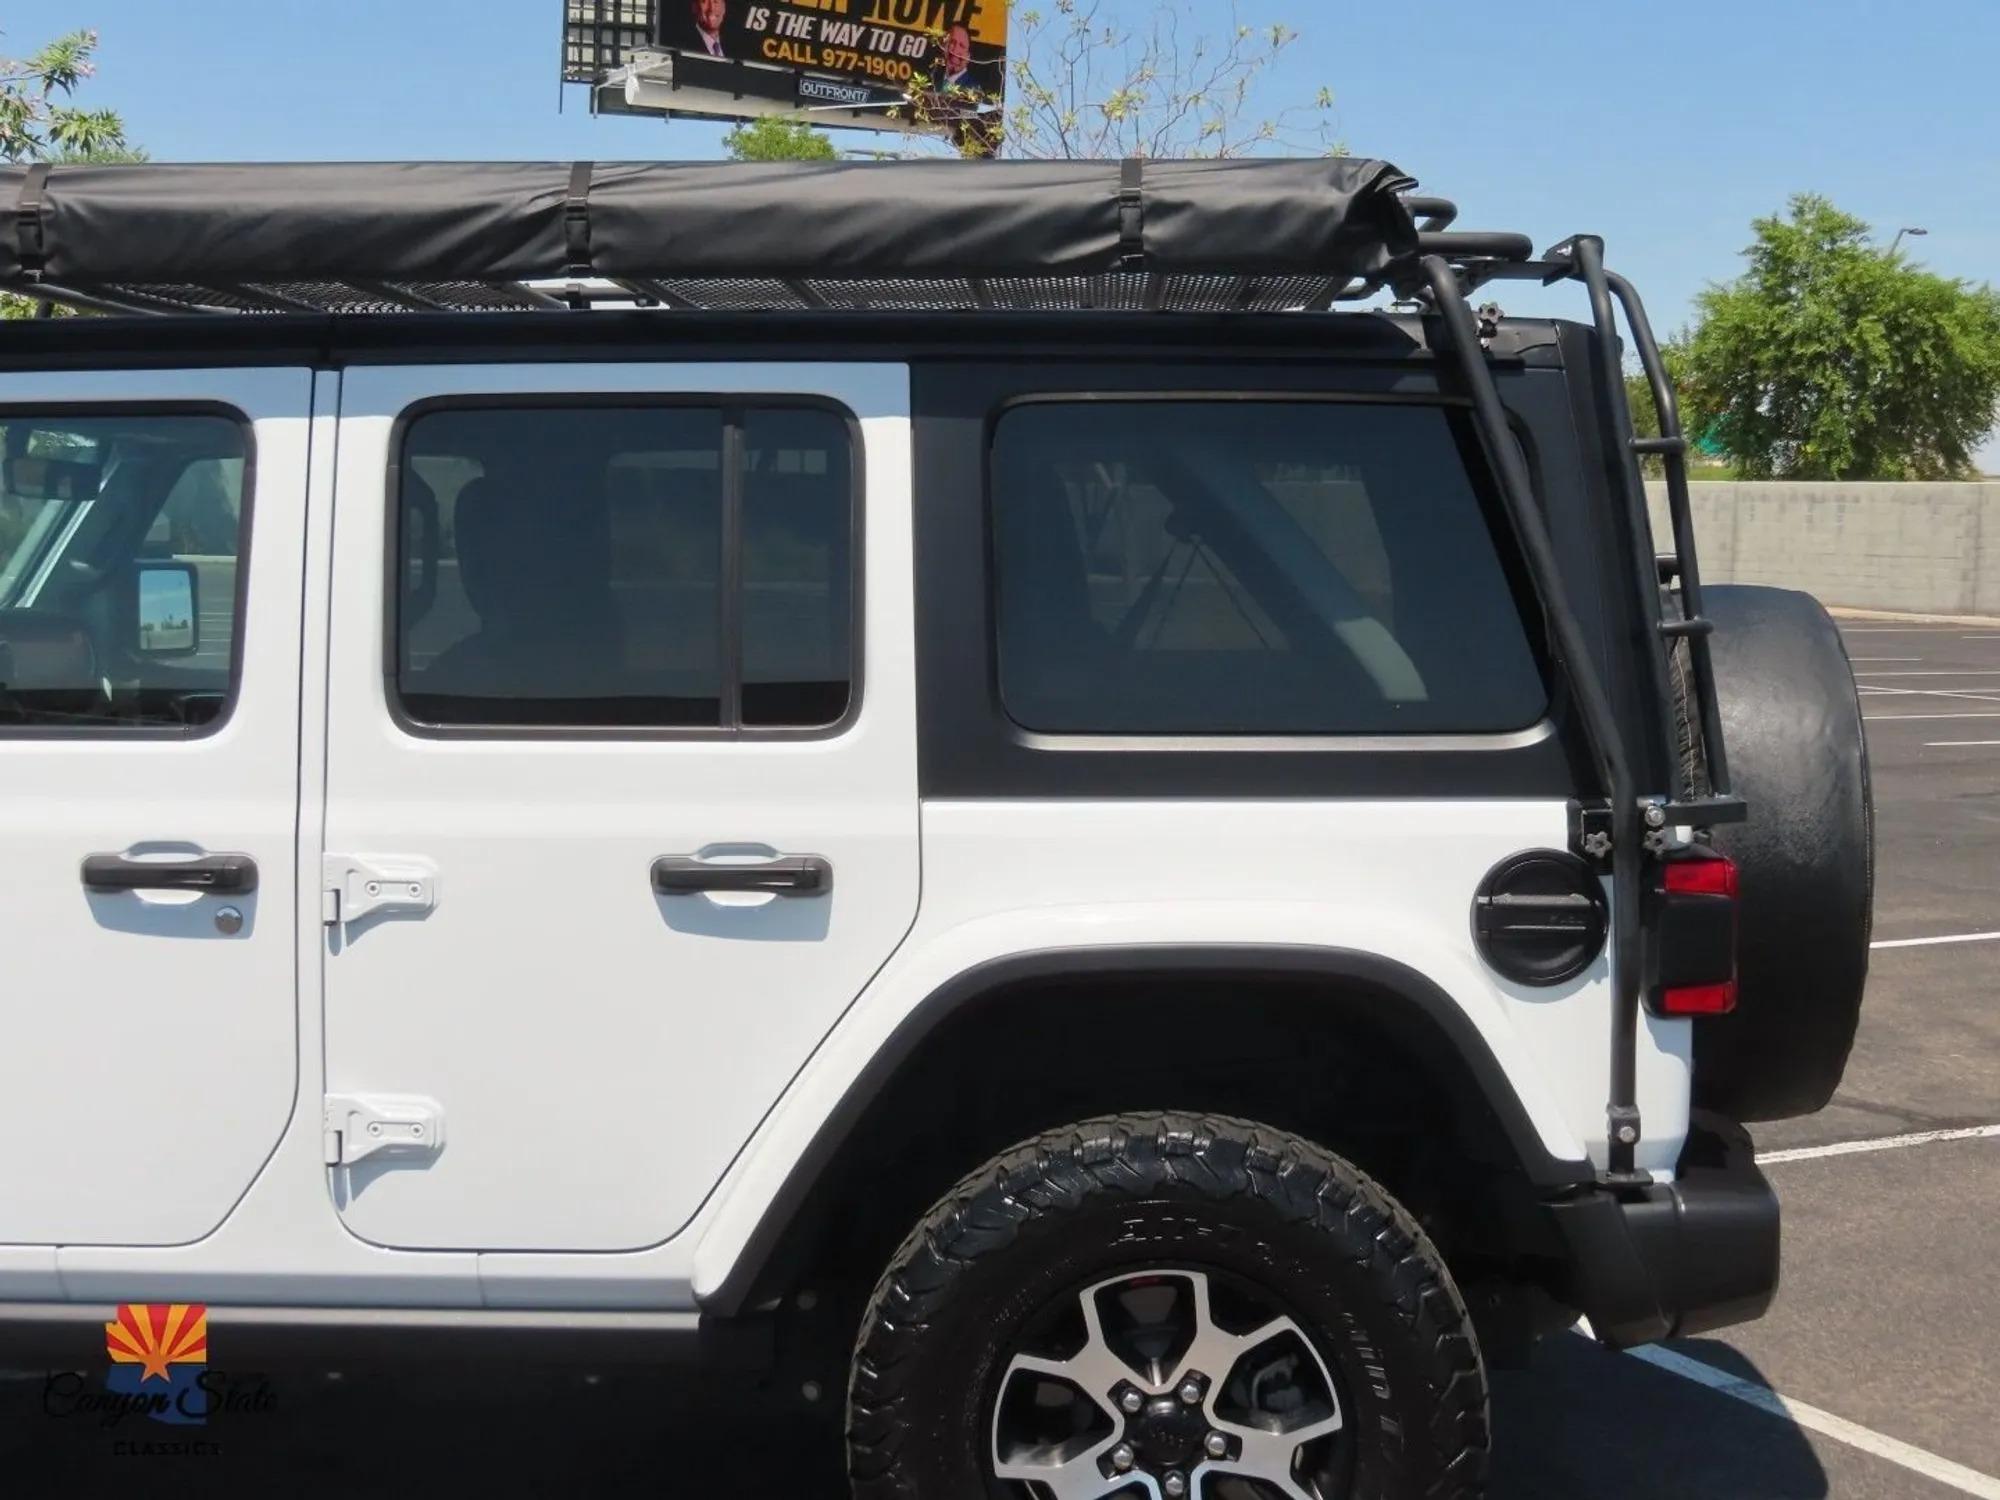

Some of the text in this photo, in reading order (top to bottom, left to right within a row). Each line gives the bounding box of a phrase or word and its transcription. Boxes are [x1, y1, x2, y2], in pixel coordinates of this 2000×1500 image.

[745, 6, 770, 31] IS
[775, 11, 818, 40] THE
[820, 19, 867, 49] WAY
[868, 29, 896, 53] TO
[898, 34, 928, 59] GO
[762, 39, 912, 80] CALL 977-1900
